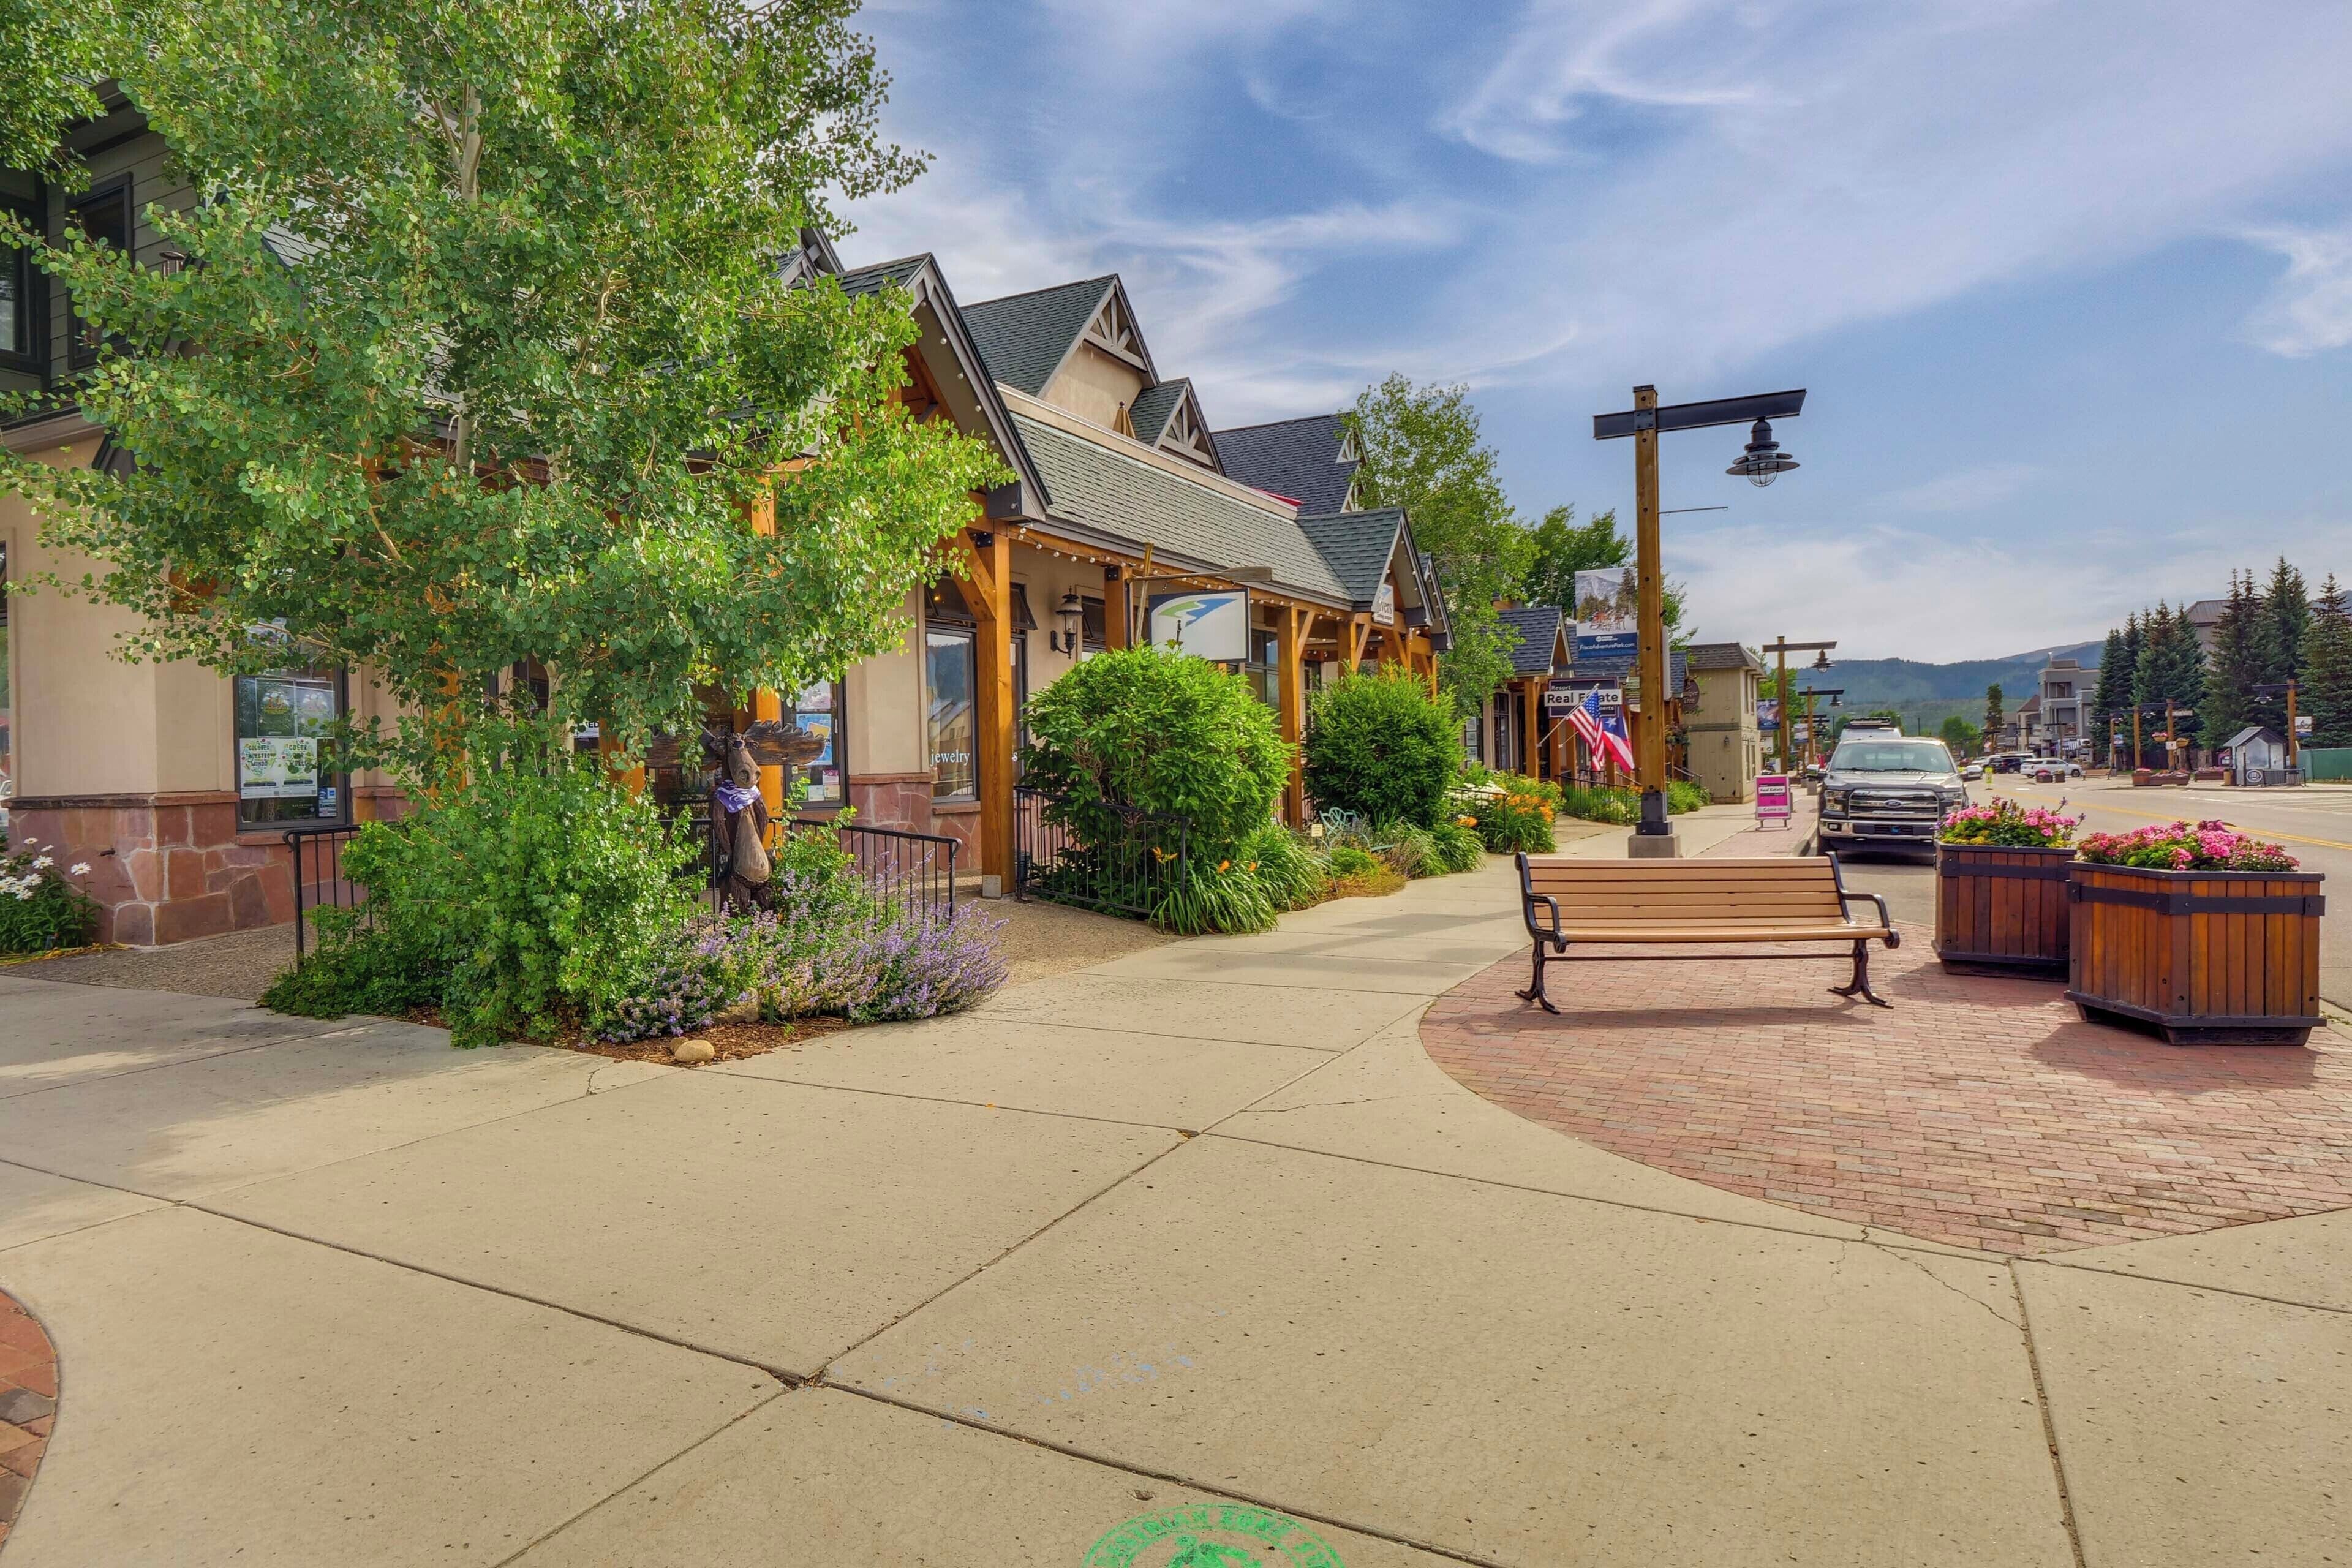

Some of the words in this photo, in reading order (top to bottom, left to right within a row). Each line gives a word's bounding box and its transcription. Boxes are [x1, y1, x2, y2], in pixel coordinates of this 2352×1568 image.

[1547, 692, 1574, 704] Real
[1578, 692, 1619, 703] Eate
[930, 748, 970, 766] jewelry
